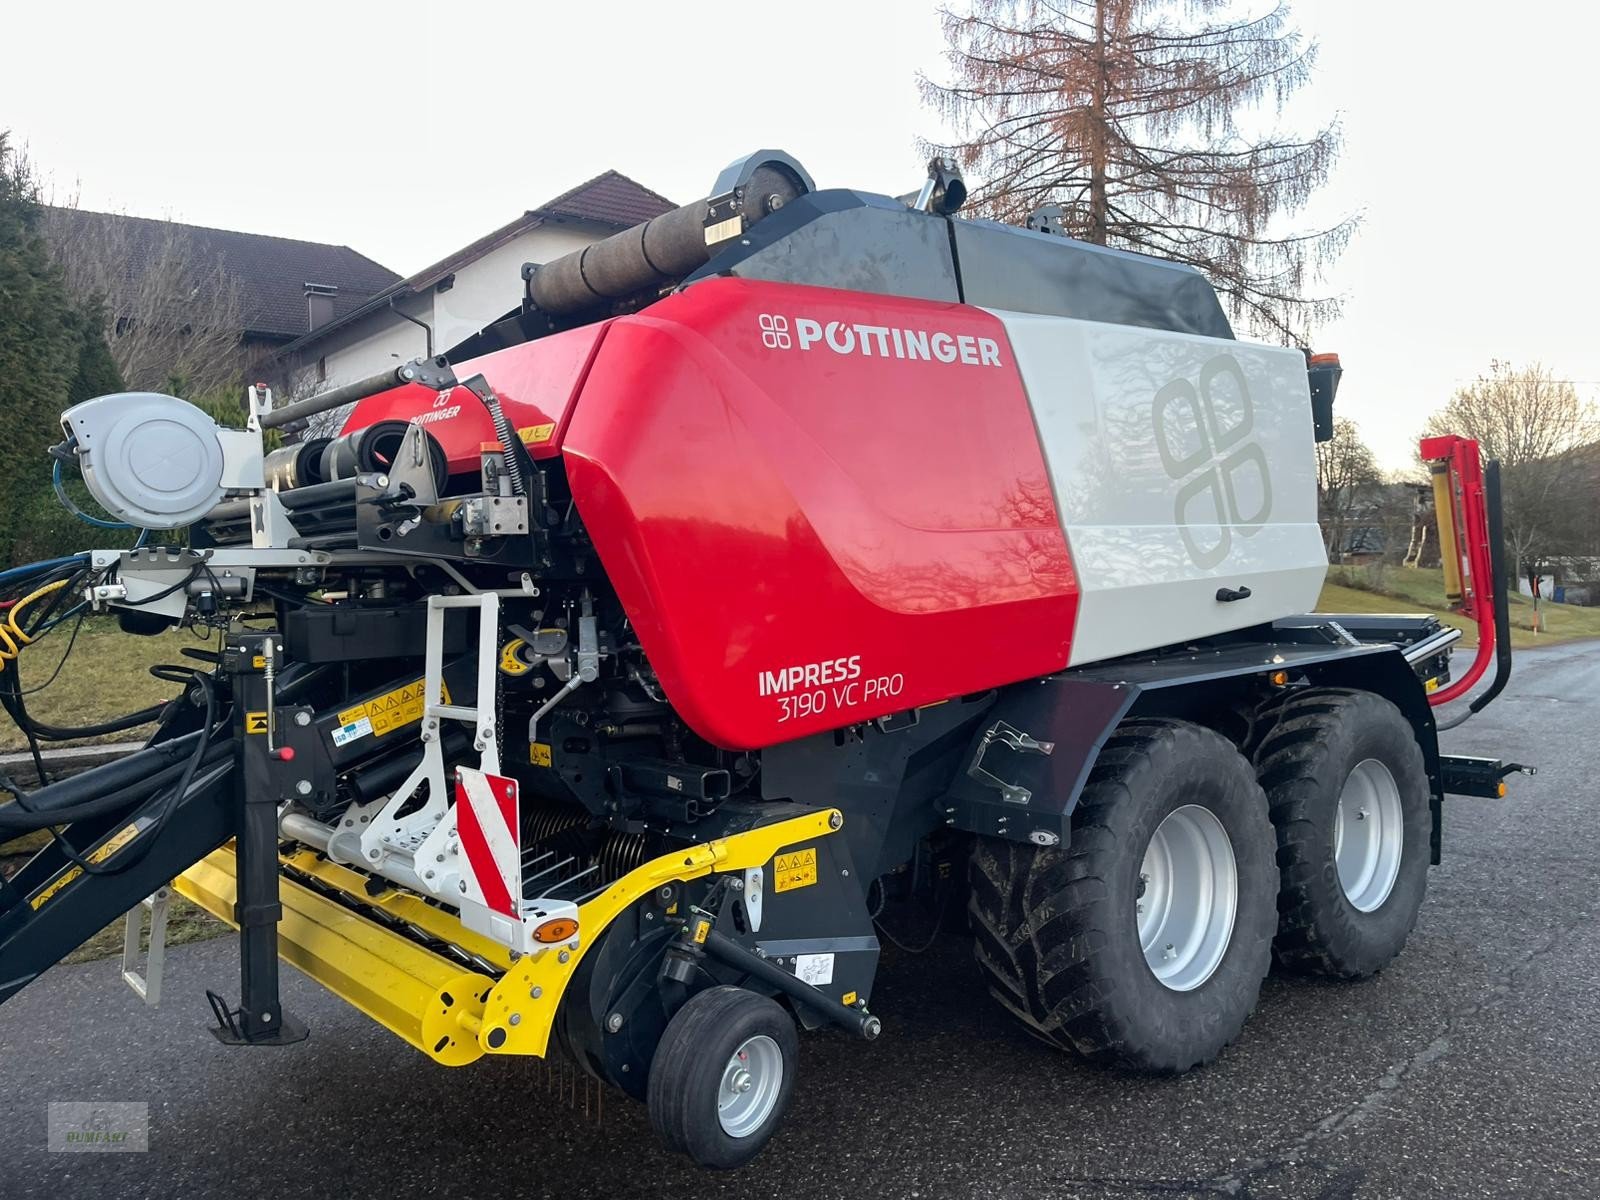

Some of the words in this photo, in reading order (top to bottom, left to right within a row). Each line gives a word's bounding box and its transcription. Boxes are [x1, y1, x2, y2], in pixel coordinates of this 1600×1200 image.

[795, 317, 1002, 367] PÖTTINGER
[758, 655, 861, 696] IMPRESS
[777, 690, 826, 723] 3190
[832, 682, 859, 709] VC
[864, 673, 904, 702] PRO
